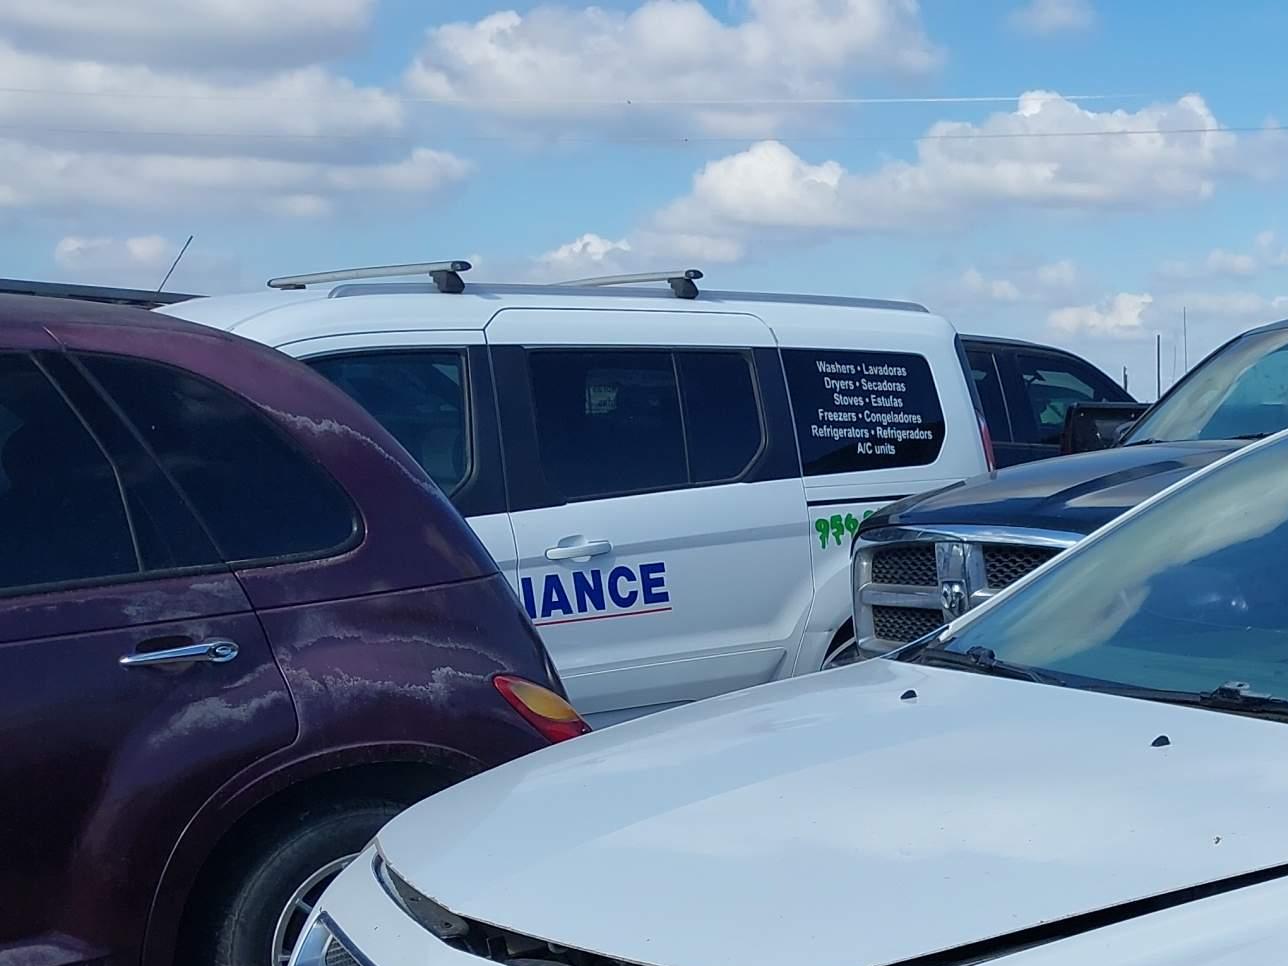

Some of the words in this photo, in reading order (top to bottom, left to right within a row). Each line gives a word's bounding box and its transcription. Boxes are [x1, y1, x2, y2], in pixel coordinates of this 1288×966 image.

[816, 361, 856, 374] Washers
[862, 363, 907, 376] Lavadoras
[824, 377, 854, 392] Dryers
[861, 379, 906, 392] Secadoras
[833, 393, 864, 406] Stoves
[870, 395, 903, 407] Estufas
[818, 409, 857, 422] Freezers
[863, 410, 922, 425] Congeladores
[811, 425, 869, 440] Refrigerators
[876, 427, 933, 441] Refrigeradors
[857, 443, 873, 454] A/C
[874, 443, 896, 454] units
